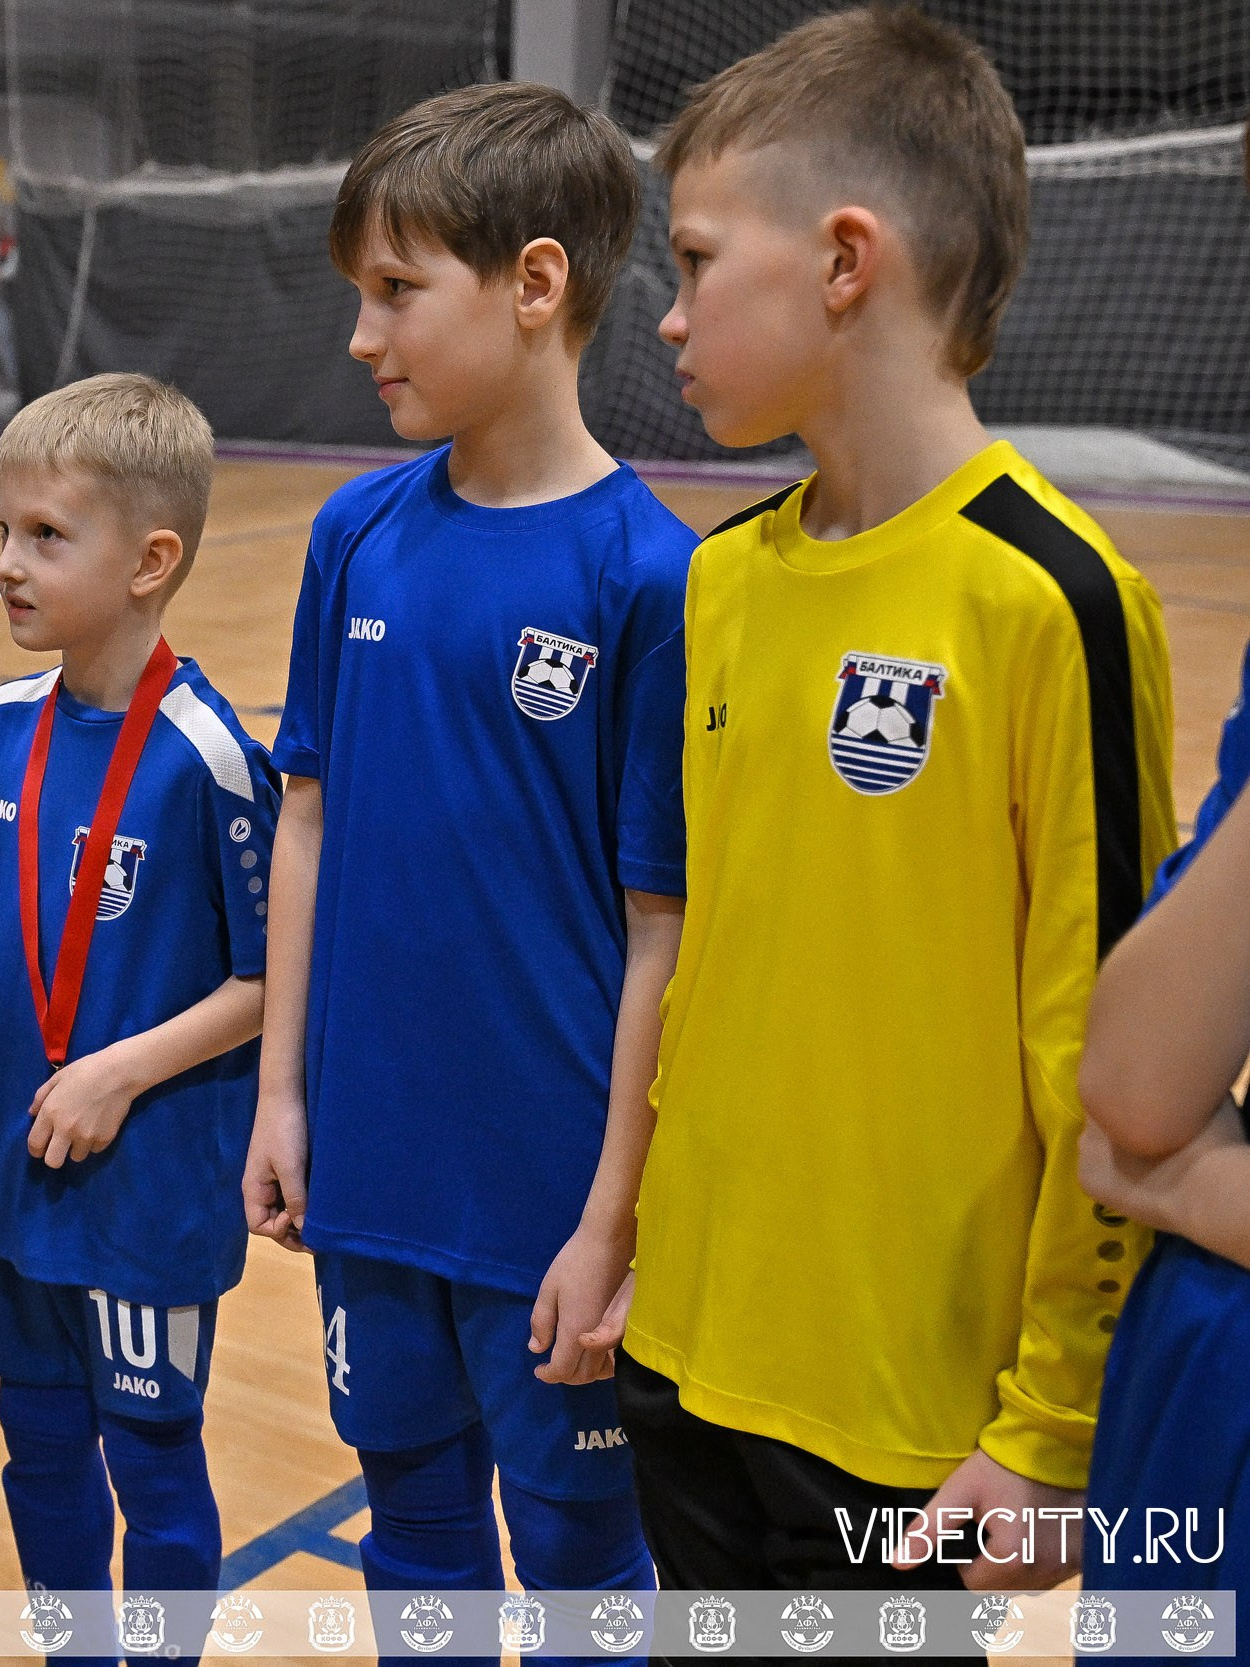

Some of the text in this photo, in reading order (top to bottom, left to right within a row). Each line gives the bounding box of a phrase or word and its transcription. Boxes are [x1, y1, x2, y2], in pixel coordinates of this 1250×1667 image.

[348, 617, 386, 642] JAKO
[536, 634, 584, 656] БАЛТИКА
[859, 661, 923, 681] БАЛТИКА
[88, 1288, 157, 1369] 10
[113, 1372, 160, 1399] JAKO
[574, 1427, 629, 1450] JAK
